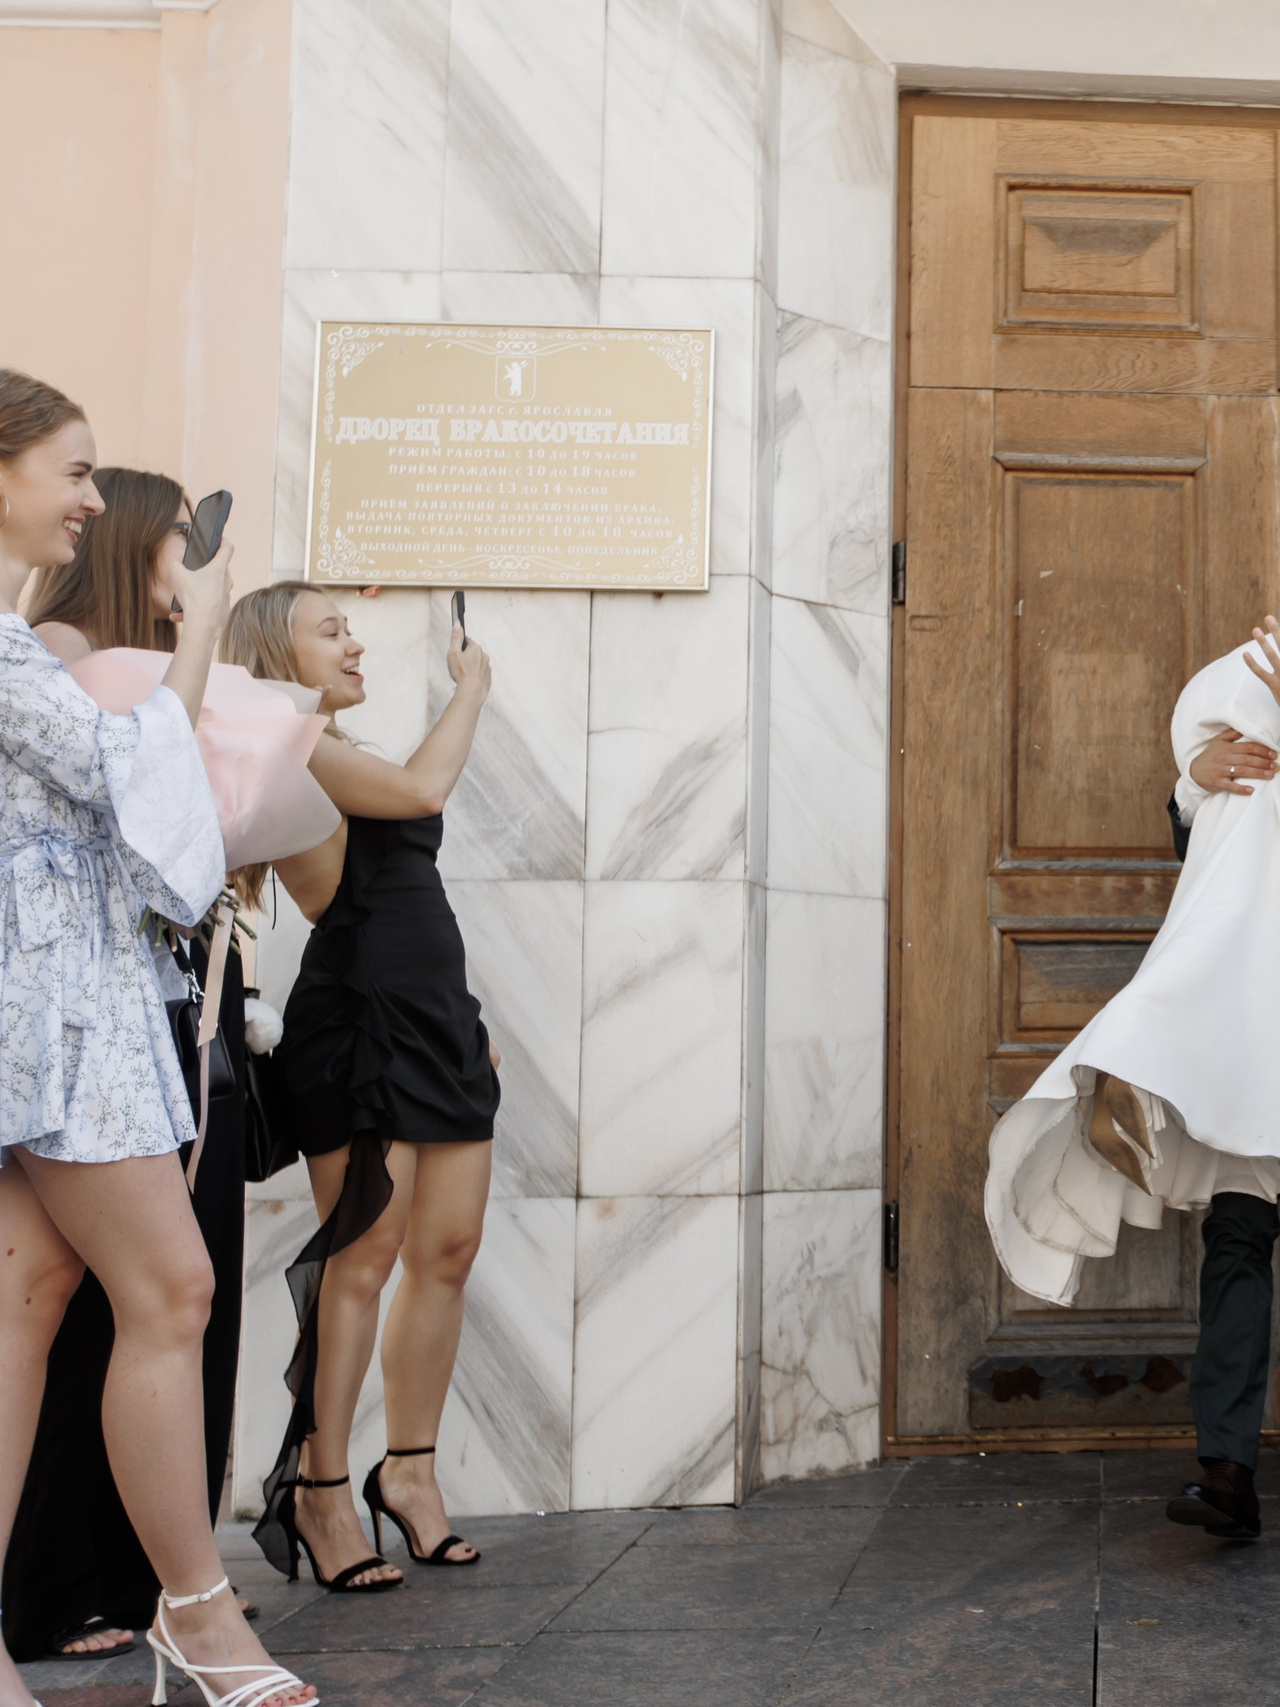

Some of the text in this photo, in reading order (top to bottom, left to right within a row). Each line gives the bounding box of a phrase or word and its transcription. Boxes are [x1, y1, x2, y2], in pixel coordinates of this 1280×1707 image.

[416, 403, 465, 416] ОТДЕЛ
[468, 404, 504, 416] ЗАГС
[522, 405, 613, 417] ЯРОСЛАВЛЯ
[335, 416, 690, 446] ДВОРЕЦ БРАКОСОЧЕТАНИЯ
[388, 447, 442, 457] РЕЖИМ
[527, 448, 546, 460] 10
[572, 449, 591, 461] 19
[389, 462, 438, 475] ПРИЁМ
[527, 465, 547, 477] 10
[571, 465, 591, 478] 18
[416, 481, 483, 493] ПЕРЕРЫВ
[497, 482, 517, 494] 13
[543, 482, 562, 495] 14
[360, 498, 408, 509] ПРИЁМ
[412, 499, 496, 511] ЗАЯВЛЕНИЙ
[346, 510, 402, 522] ВЫДАЧА
[407, 511, 493, 523] ПОВТОРНЫХ
[498, 513, 591, 525] ДОКУМЕНТОВ
[596, 514, 613, 525] ИЗ
[474, 526, 532, 537] ЧЕТВЕРГ
[552, 525, 572, 537] 10
[602, 526, 623, 538] 18
[360, 540, 430, 553] ВЫХОДНОЙ
[432, 542, 466, 553] ДЕНЬ
[567, 545, 660, 556] ПОНЕДЕЛЬНИК
